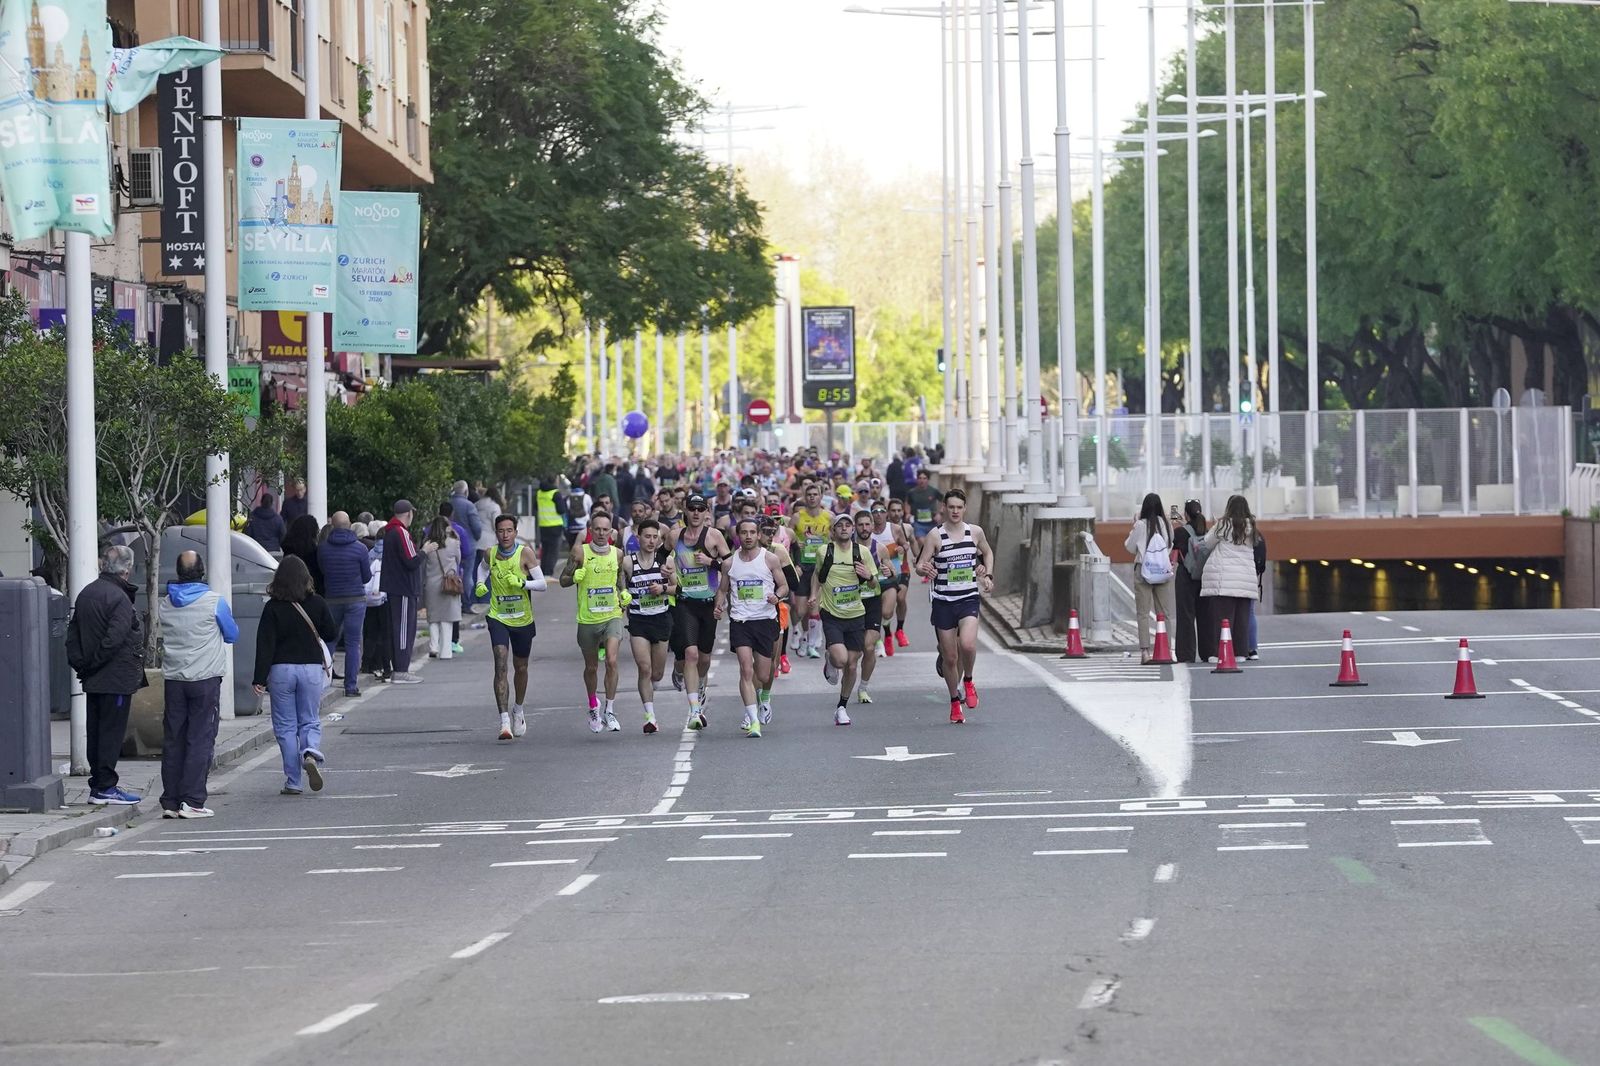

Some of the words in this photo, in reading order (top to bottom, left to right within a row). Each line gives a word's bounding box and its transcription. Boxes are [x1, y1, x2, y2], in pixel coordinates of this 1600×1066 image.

[172, 68, 199, 234] JENTOFT
[244, 232, 333, 253] SEVILLA
[352, 265, 386, 274] MARATÓN
[352, 275, 386, 283] SEVILLA
[268, 345, 328, 356] TABAC
[228, 378, 253, 387] OCK
[818, 388, 851, 402] 8:55
[947, 554, 973, 562] HIGHGATE
